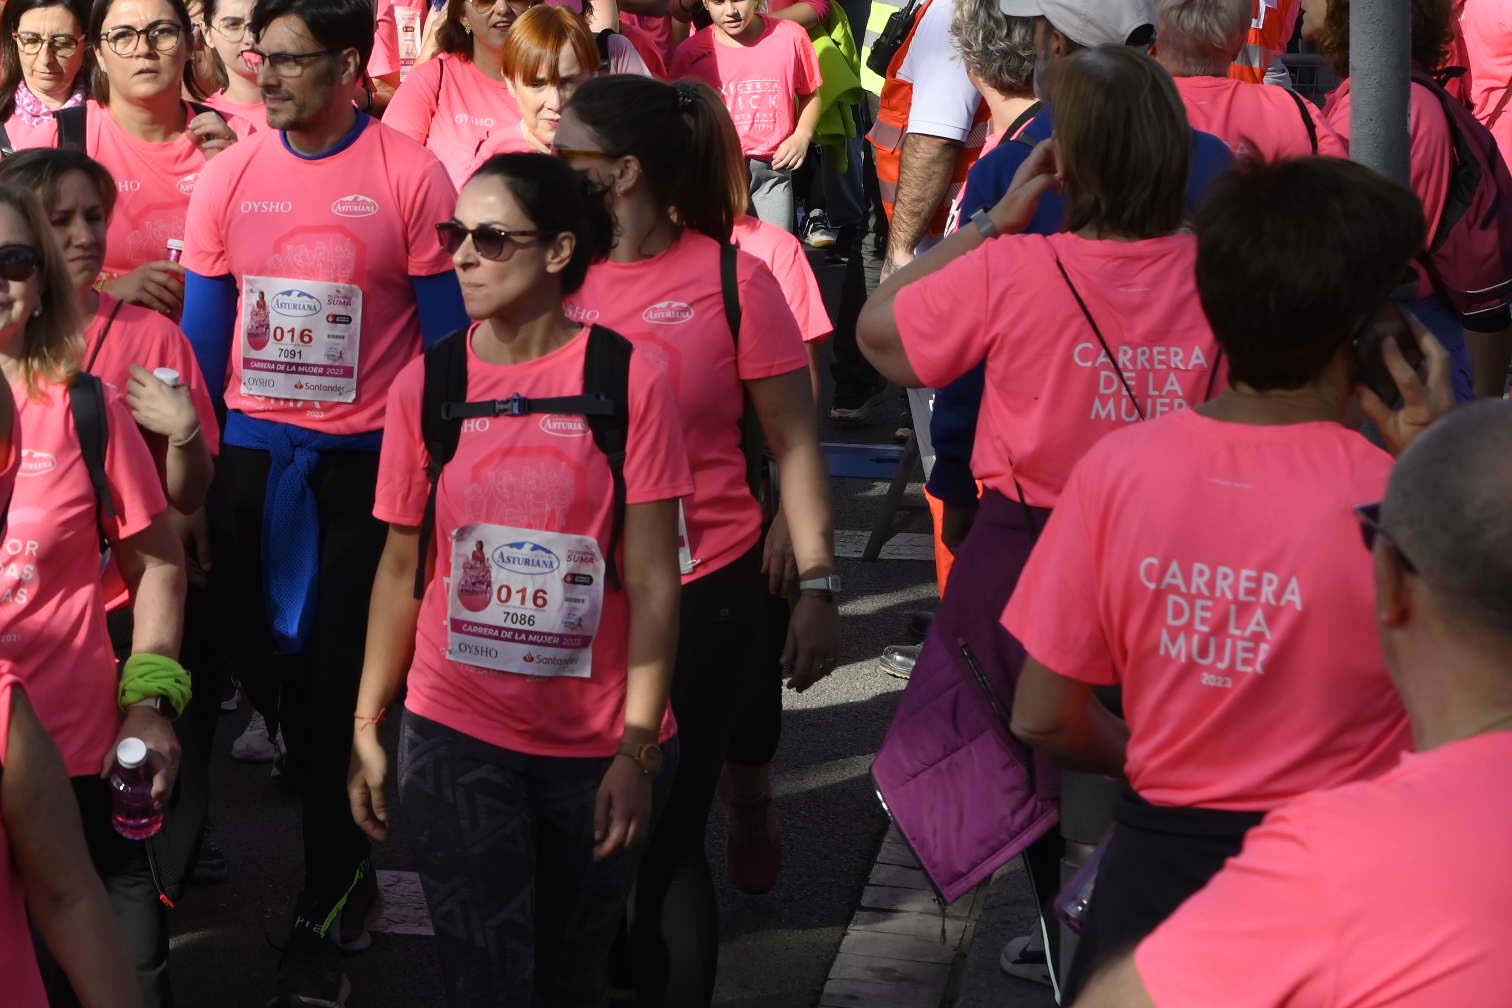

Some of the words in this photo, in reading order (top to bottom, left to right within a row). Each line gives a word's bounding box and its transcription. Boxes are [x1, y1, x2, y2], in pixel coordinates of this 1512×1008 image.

[240, 200, 292, 214] OYSHO
[273, 298, 319, 313] ASTURIANA
[564, 303, 600, 322] SHO
[272, 325, 314, 345] 016
[277, 347, 303, 361] 7091
[1073, 341, 1209, 371] CARRERA
[304, 382, 346, 392] Santander
[1098, 371, 1133, 395] DE
[1148, 372, 1183, 395] LA
[1090, 397, 1188, 421] MUJER
[6, 539, 39, 556] OR
[495, 549, 556, 570] ASTURIANA
[1139, 557, 1303, 611] CARRERA
[495, 584, 549, 609] 016
[502, 611, 537, 627] 7086
[1166, 596, 1213, 633] DE
[1228, 602, 1272, 640] LA
[501, 630, 513, 639] DE
[514, 632, 527, 641] LA
[458, 642, 499, 659] OYSHO
[1159, 629, 1270, 674] MUJER
